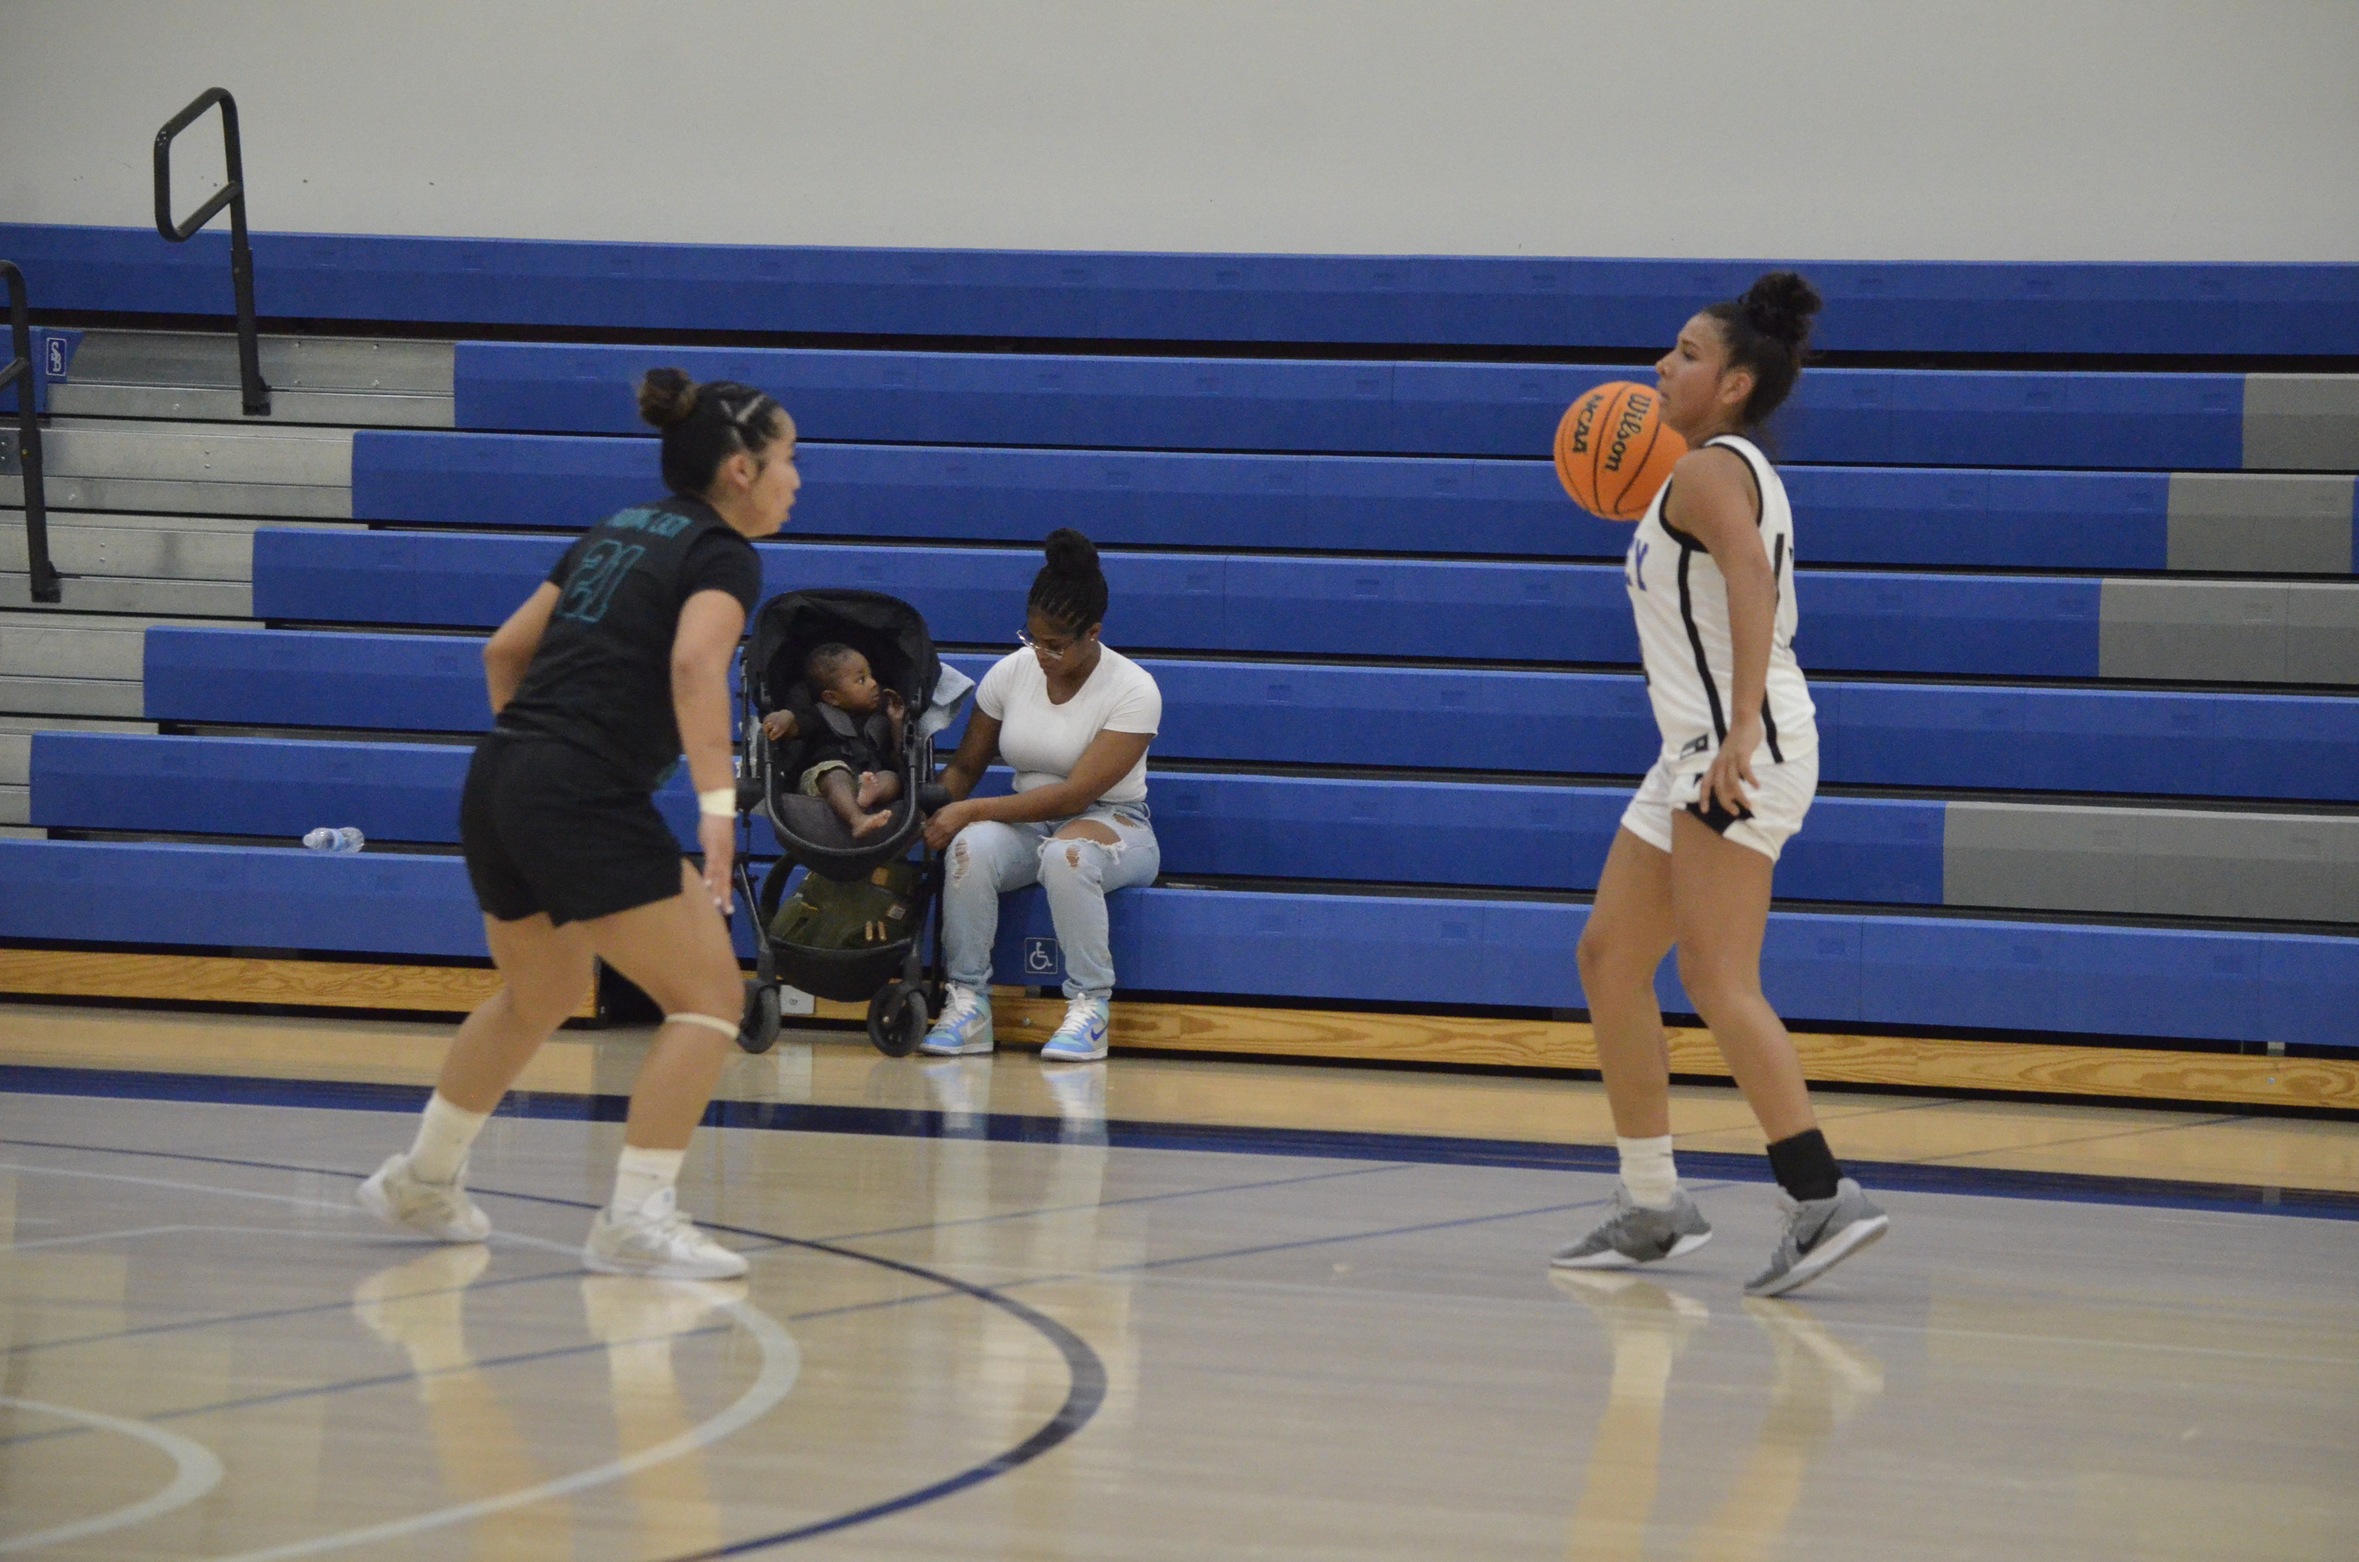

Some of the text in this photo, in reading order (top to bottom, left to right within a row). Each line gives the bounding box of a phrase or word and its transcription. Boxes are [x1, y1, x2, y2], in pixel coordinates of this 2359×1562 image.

[1573, 395, 1605, 454] NCAA
[1605, 393, 1652, 471] Wilson
[556, 539, 647, 623] 21
